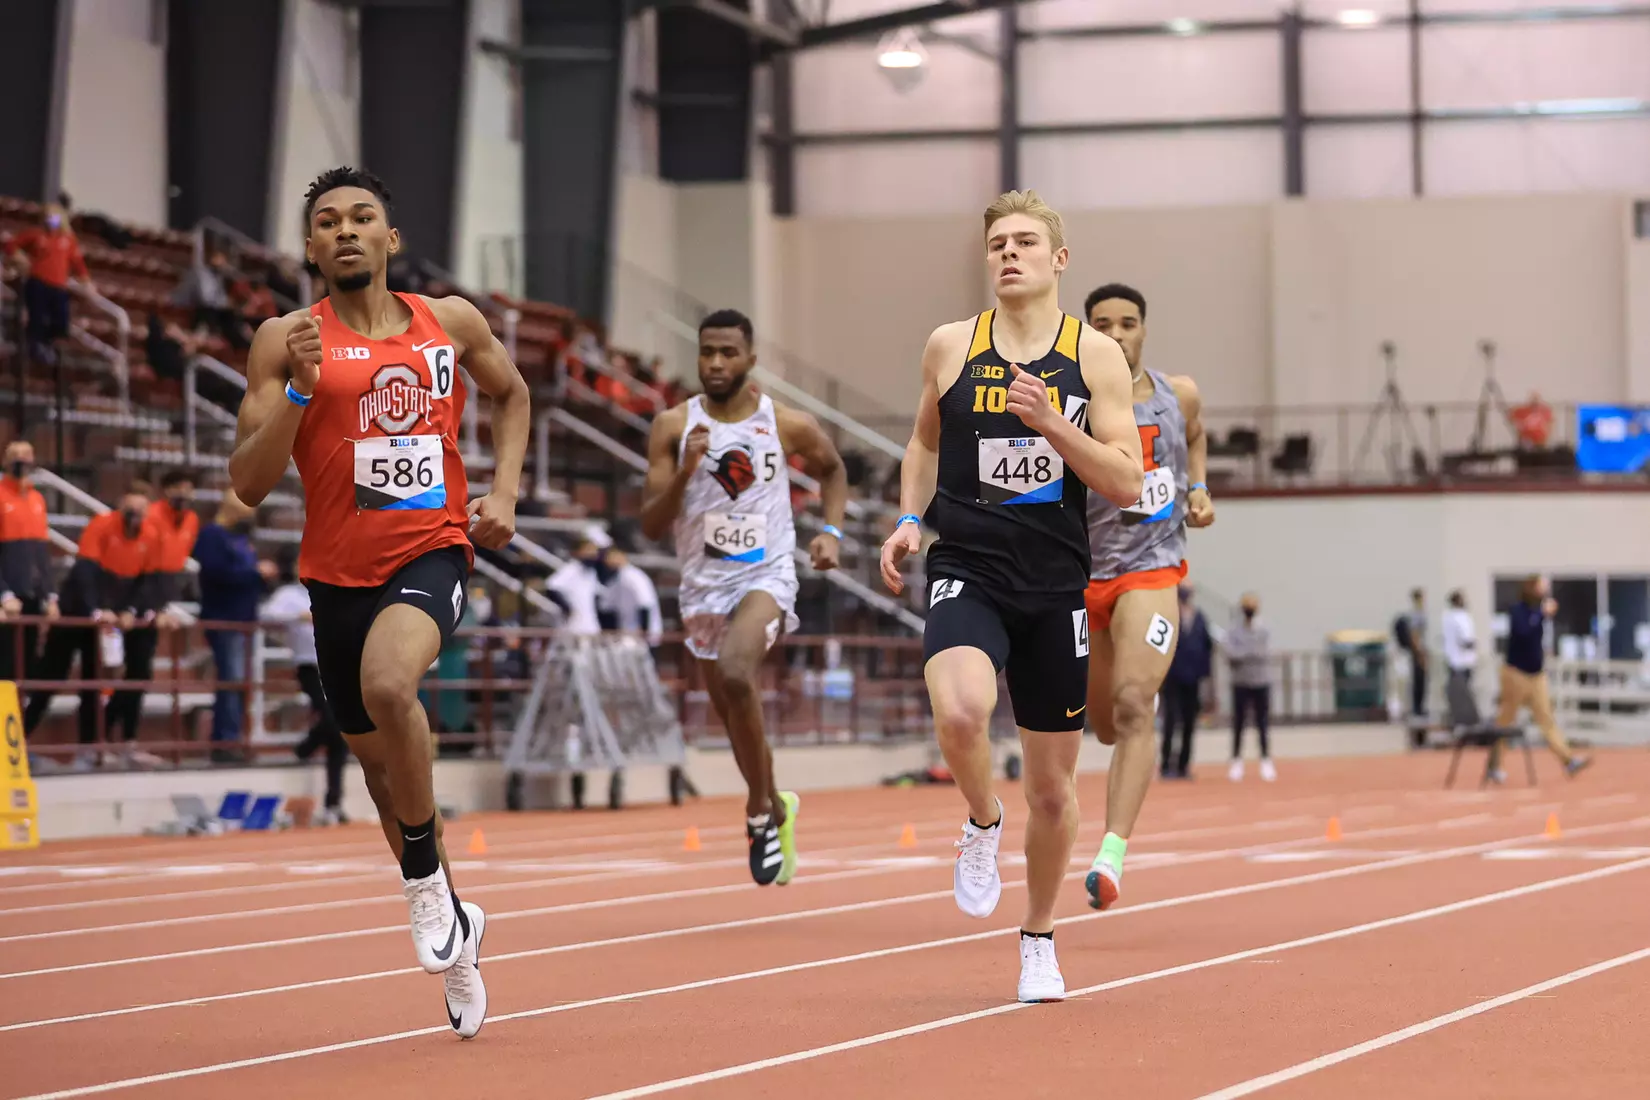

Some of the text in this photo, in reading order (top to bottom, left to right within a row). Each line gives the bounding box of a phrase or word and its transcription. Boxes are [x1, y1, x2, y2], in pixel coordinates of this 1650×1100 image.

[435, 349, 450, 395] 6
[973, 386, 1063, 413] IOA
[370, 457, 433, 488] 586
[764, 453, 776, 482] 5
[991, 456, 1052, 484] 448
[713, 526, 757, 548] 646
[934, 578, 953, 600] 4
[1079, 612, 1088, 653] 4
[1150, 620, 1168, 647] 3
